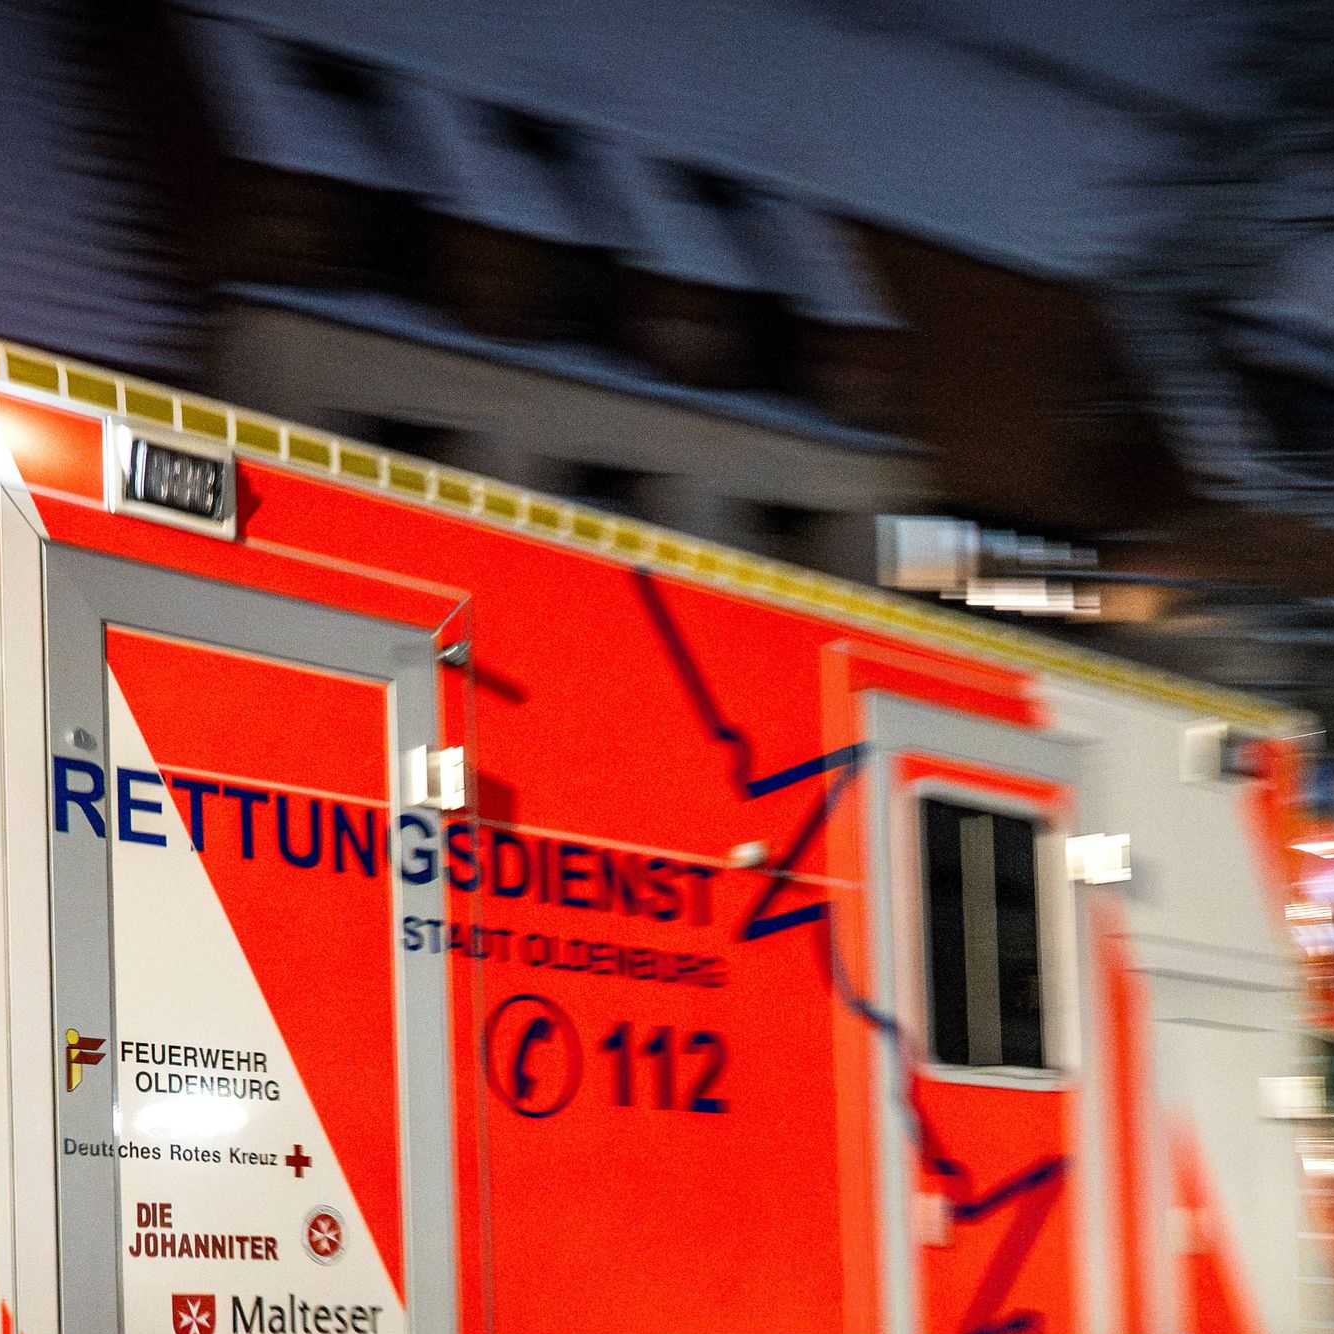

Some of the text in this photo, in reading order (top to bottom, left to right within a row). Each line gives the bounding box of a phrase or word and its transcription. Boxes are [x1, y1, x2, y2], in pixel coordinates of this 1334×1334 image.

[53, 756, 717, 926] RETTUNGSDIENST
[403, 916, 513, 963] STADT
[121, 1041, 267, 1073] FEUERWEHR
[601, 1021, 729, 1114] 112
[135, 1071, 280, 1101] OLDENBURG
[64, 1138, 278, 1166] Deutsches Rotes Kreuz
[136, 1203, 172, 1228] DIE
[129, 1233, 279, 1261] JOHANNITER
[231, 1293, 383, 1334] Malteser
